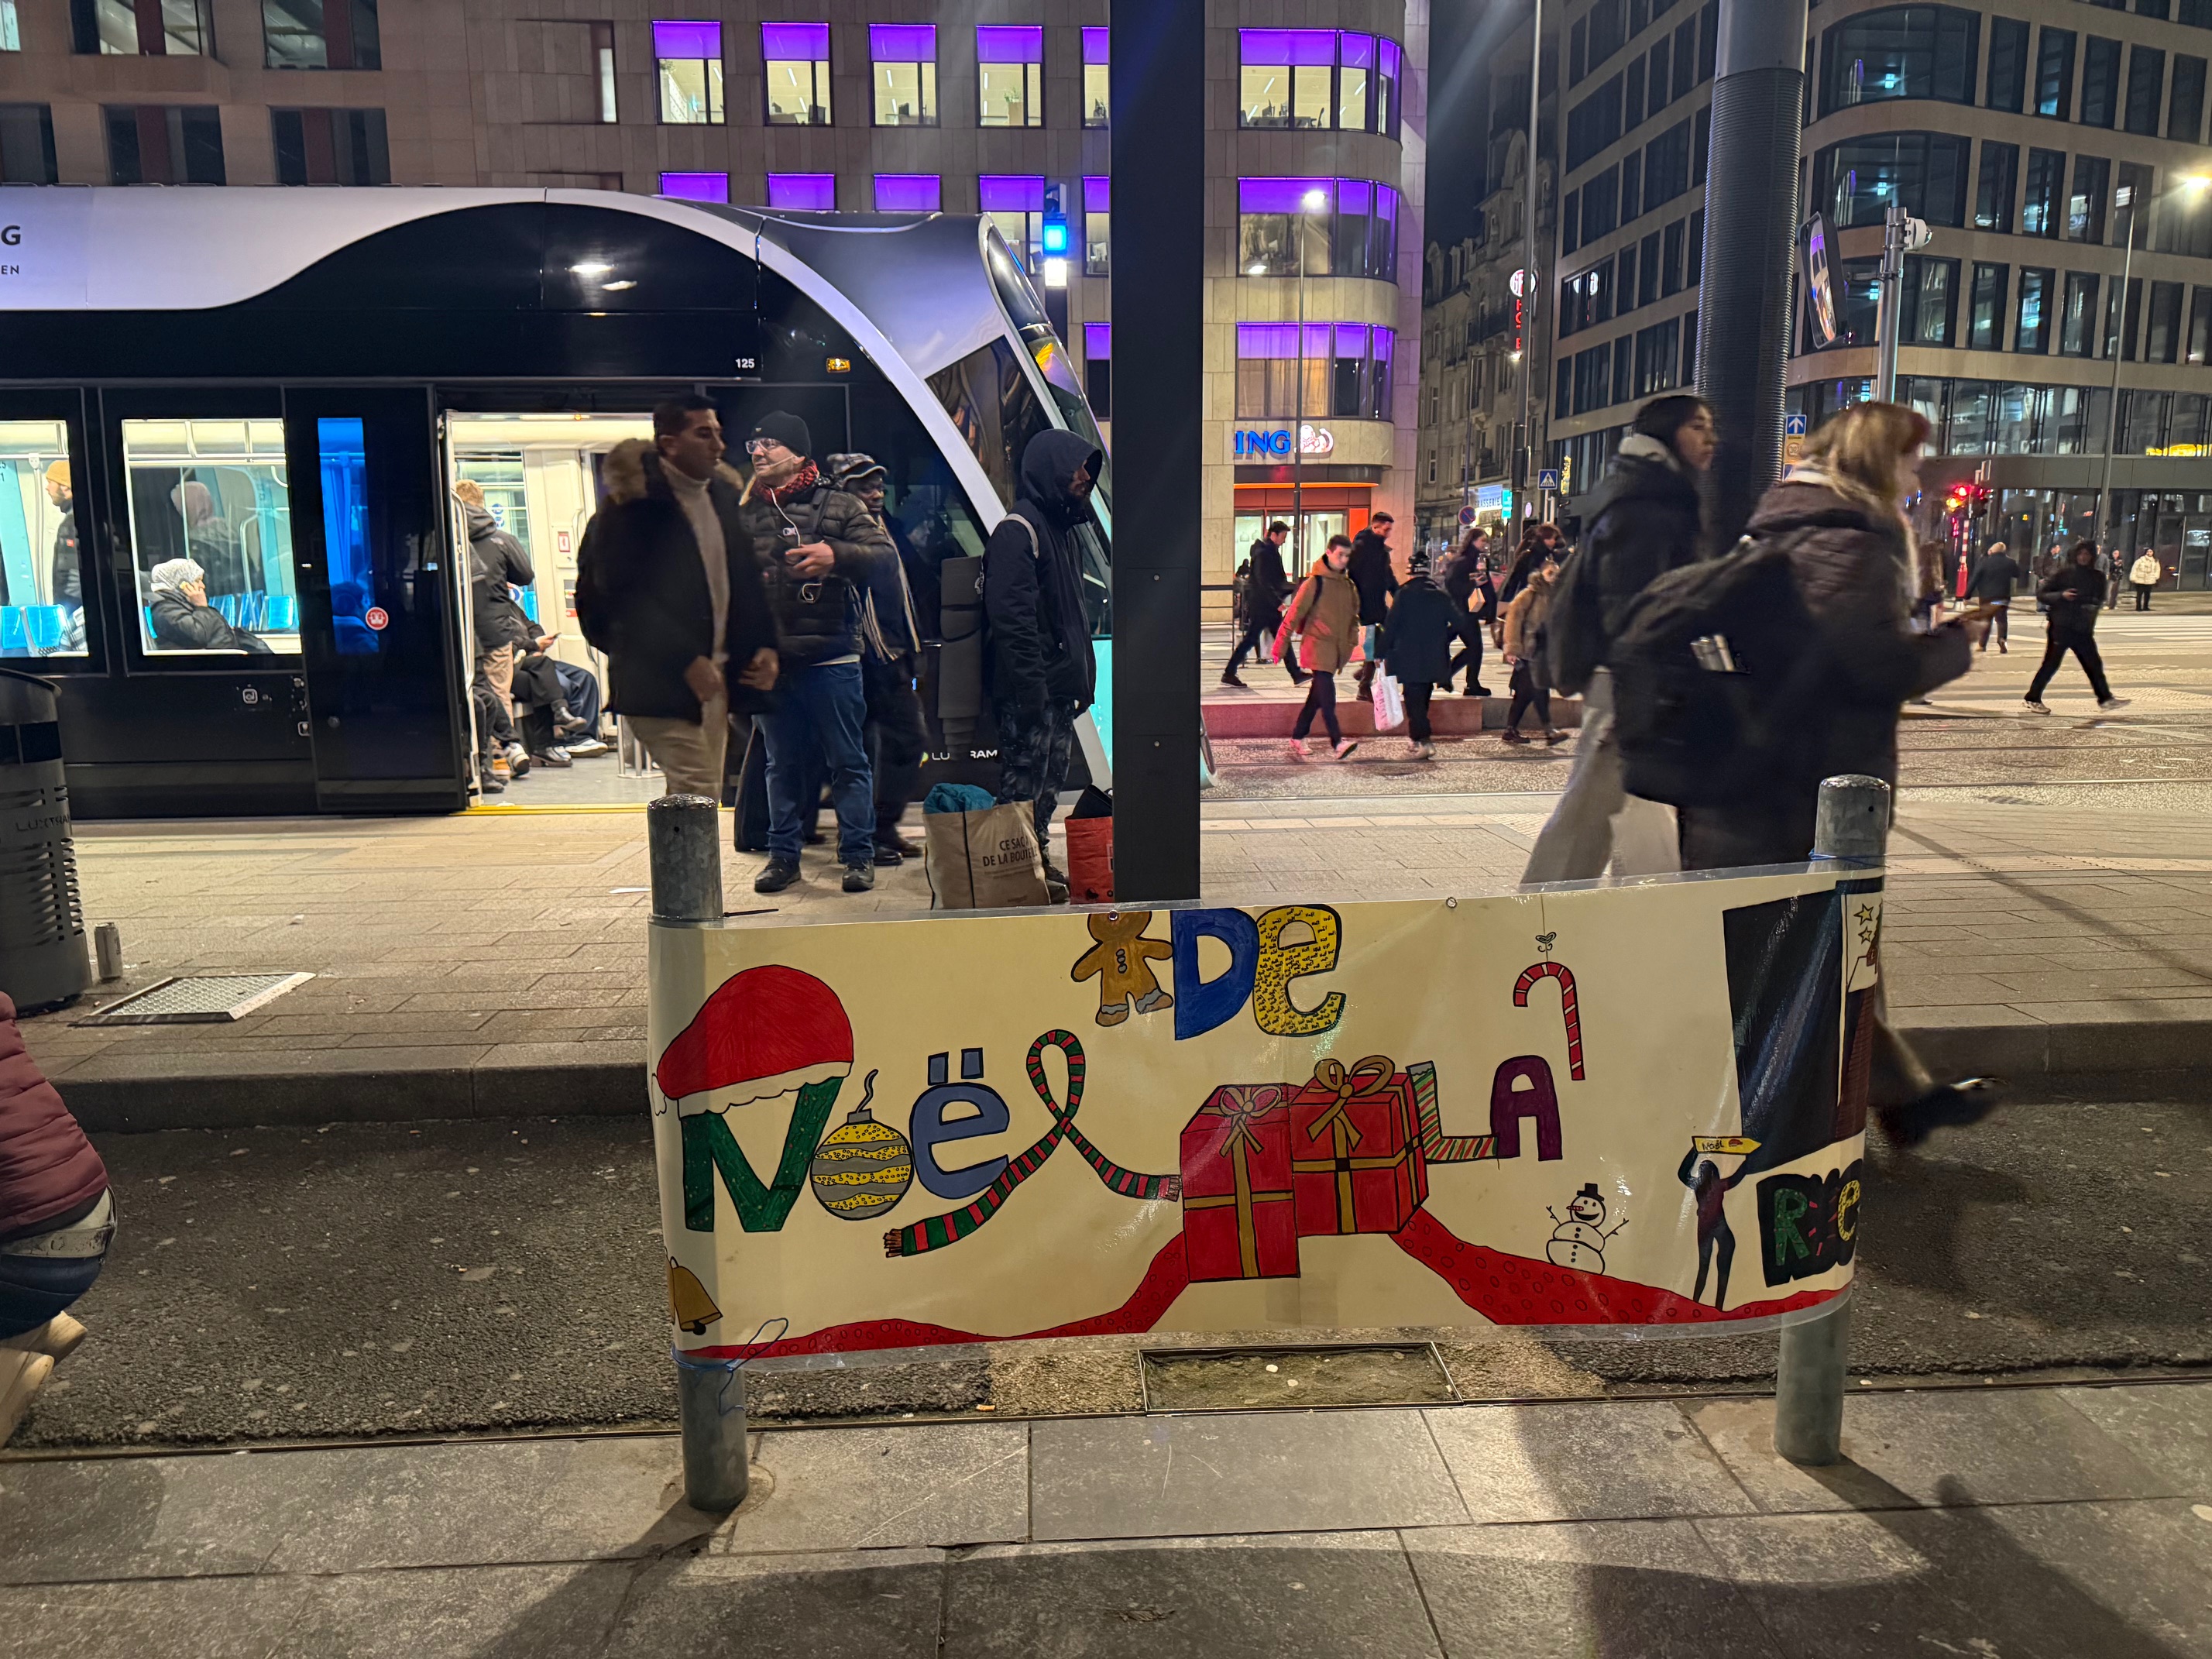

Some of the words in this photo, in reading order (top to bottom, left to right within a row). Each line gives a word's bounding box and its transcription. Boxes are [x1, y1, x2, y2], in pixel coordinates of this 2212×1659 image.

[735, 358, 755, 369] 125
[1235, 430, 1291, 455] ING
[932, 749, 998, 761] LURAM
[999, 840, 1010, 851] CE
[1011, 836, 1025, 850] SAC
[982, 855, 996, 867] DE
[998, 854, 1008, 864] LA
